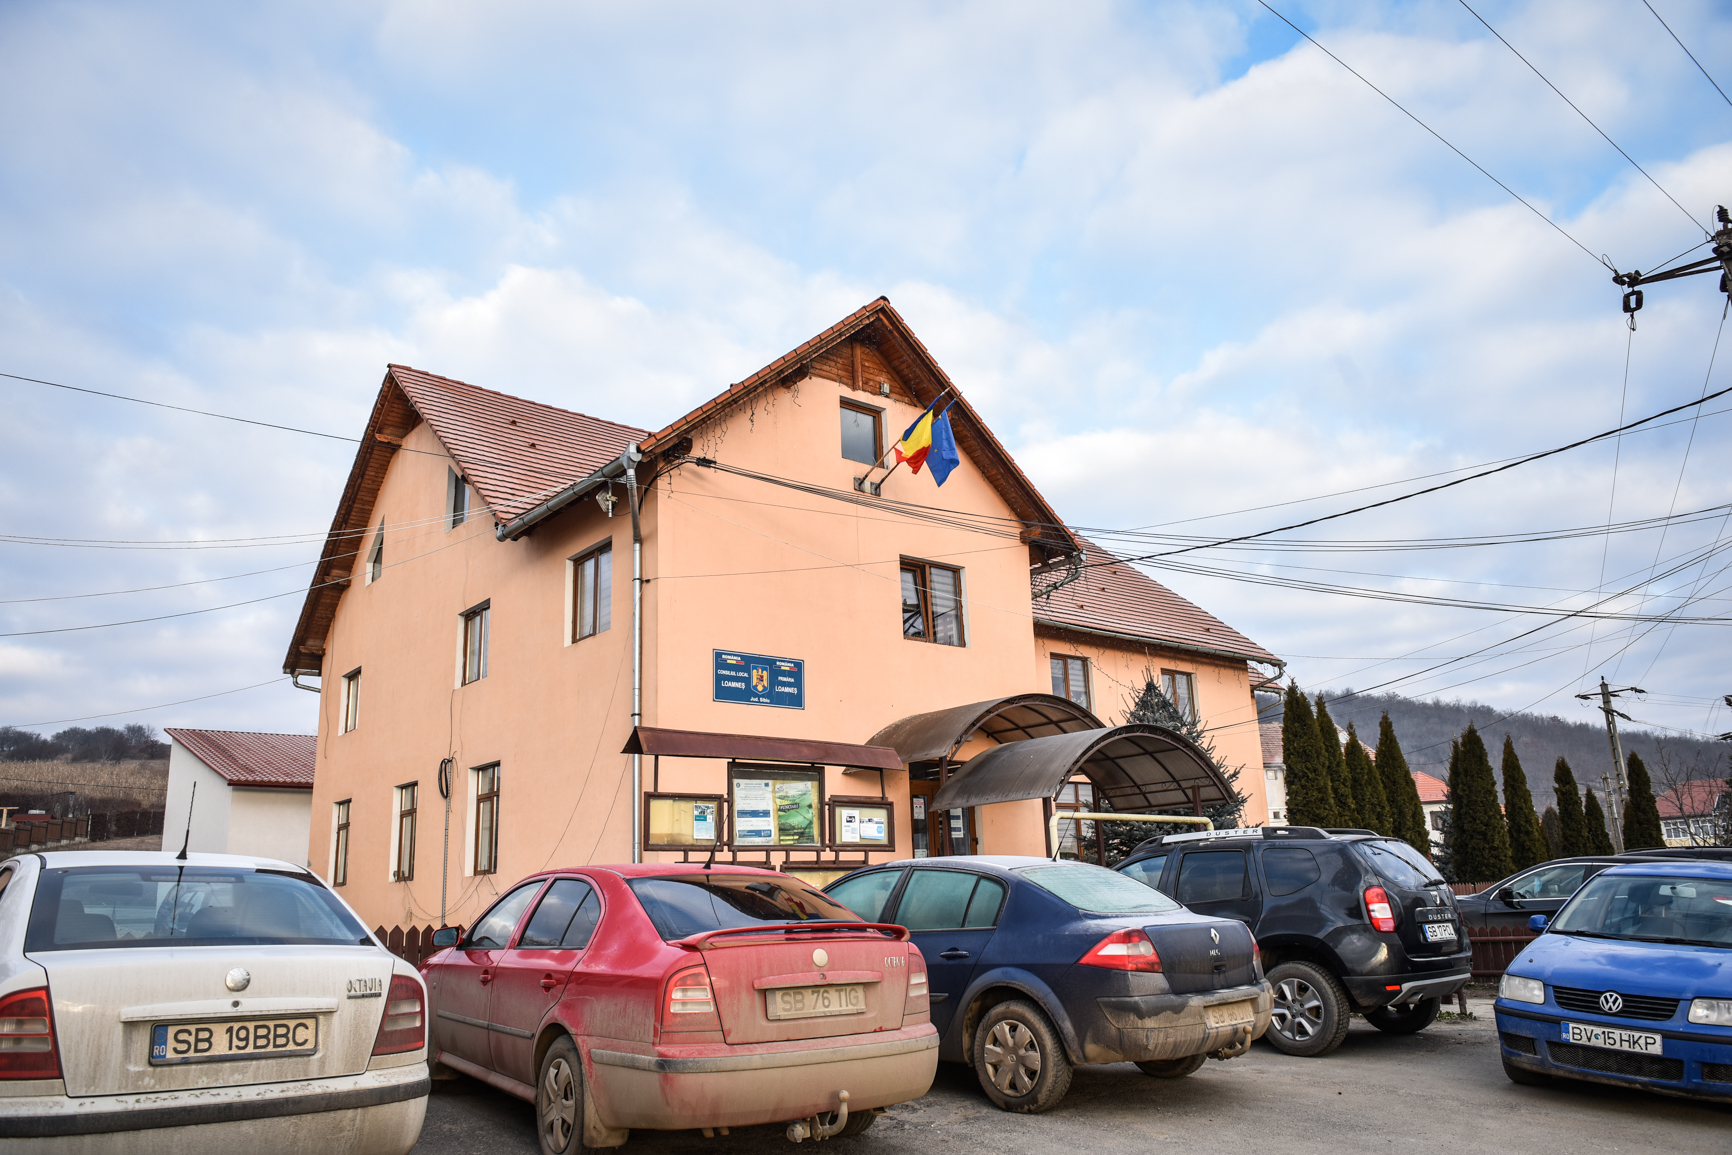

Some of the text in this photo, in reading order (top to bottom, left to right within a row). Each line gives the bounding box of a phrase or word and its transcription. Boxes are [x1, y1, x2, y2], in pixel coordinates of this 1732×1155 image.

[1206, 829, 1258, 837] DUSTER
[1428, 913, 1452, 921] DUSTER
[1427, 925, 1438, 938] SB
[346, 977, 382, 993] OCTAVIA
[780, 988, 860, 1012] SB 76 TIG
[1211, 1008, 1225, 1024] SB
[172, 1027, 213, 1054] SB
[1571, 1027, 1594, 1042] BV
[153, 1045, 166, 1056] RO
